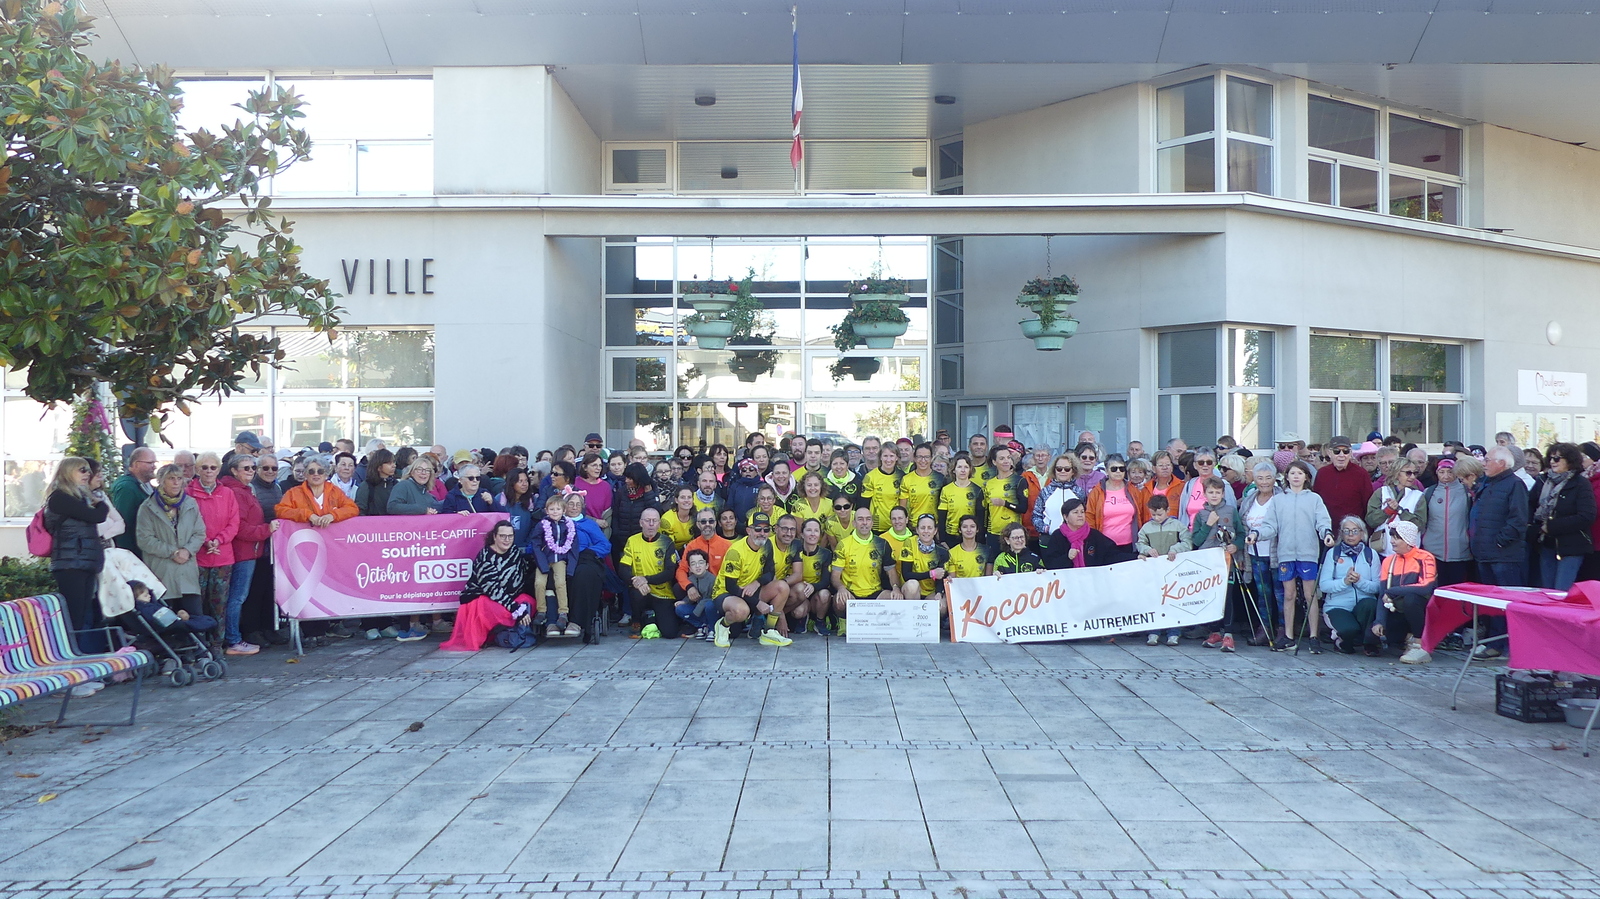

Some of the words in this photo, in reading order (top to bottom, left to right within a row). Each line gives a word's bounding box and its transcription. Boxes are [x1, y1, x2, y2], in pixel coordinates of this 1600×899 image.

[341, 258, 435, 295] VILLE
[347, 529, 478, 543] MOUILLERON-LE-CAPTIF
[382, 543, 447, 558] soutient
[356, 562, 410, 588] Octobre
[419, 562, 469, 580] ROSE
[402, 590, 434, 600] dépistage
[1161, 573, 1223, 605] Kocoon
[960, 579, 1066, 638] Kocoon
[1005, 622, 1069, 637] ENSEMBLE
[1083, 611, 1156, 631] AUTREMENT
